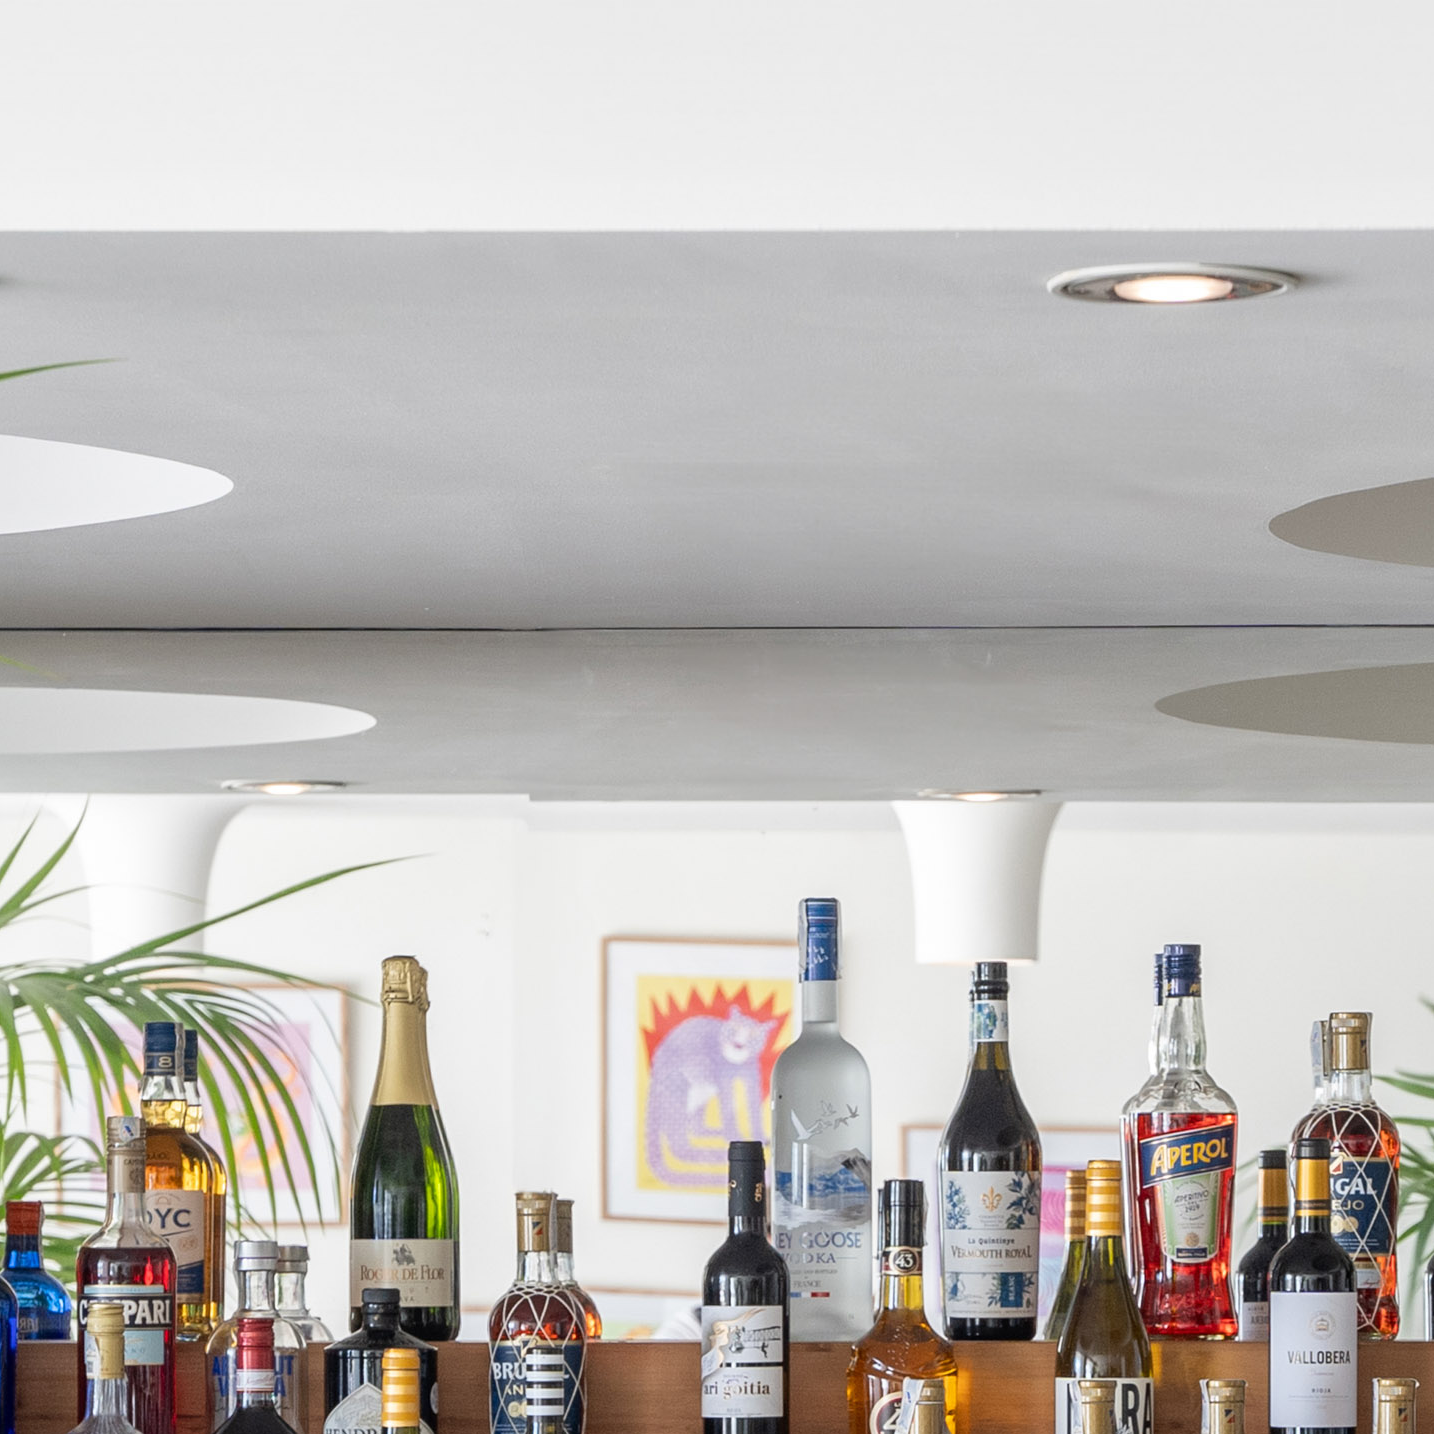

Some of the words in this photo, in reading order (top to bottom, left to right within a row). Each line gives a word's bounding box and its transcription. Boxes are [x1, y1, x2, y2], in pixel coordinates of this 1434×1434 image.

[1150, 1137, 1229, 1176] APEROL
[1174, 1189, 1210, 1203] APERITIVO
[799, 1231, 863, 1249] GOOSE
[951, 1245, 1003, 1259] VERMOUTH
[1005, 1245, 1032, 1259] ROYAL
[894, 1253, 914, 1268] 43
[402, 1266, 418, 1281] DE
[420, 1264, 445, 1281] FLOR
[792, 1280, 822, 1288] FRANCE
[1287, 1350, 1351, 1365] VALLOBERA
[723, 1380, 771, 1400] goitia
